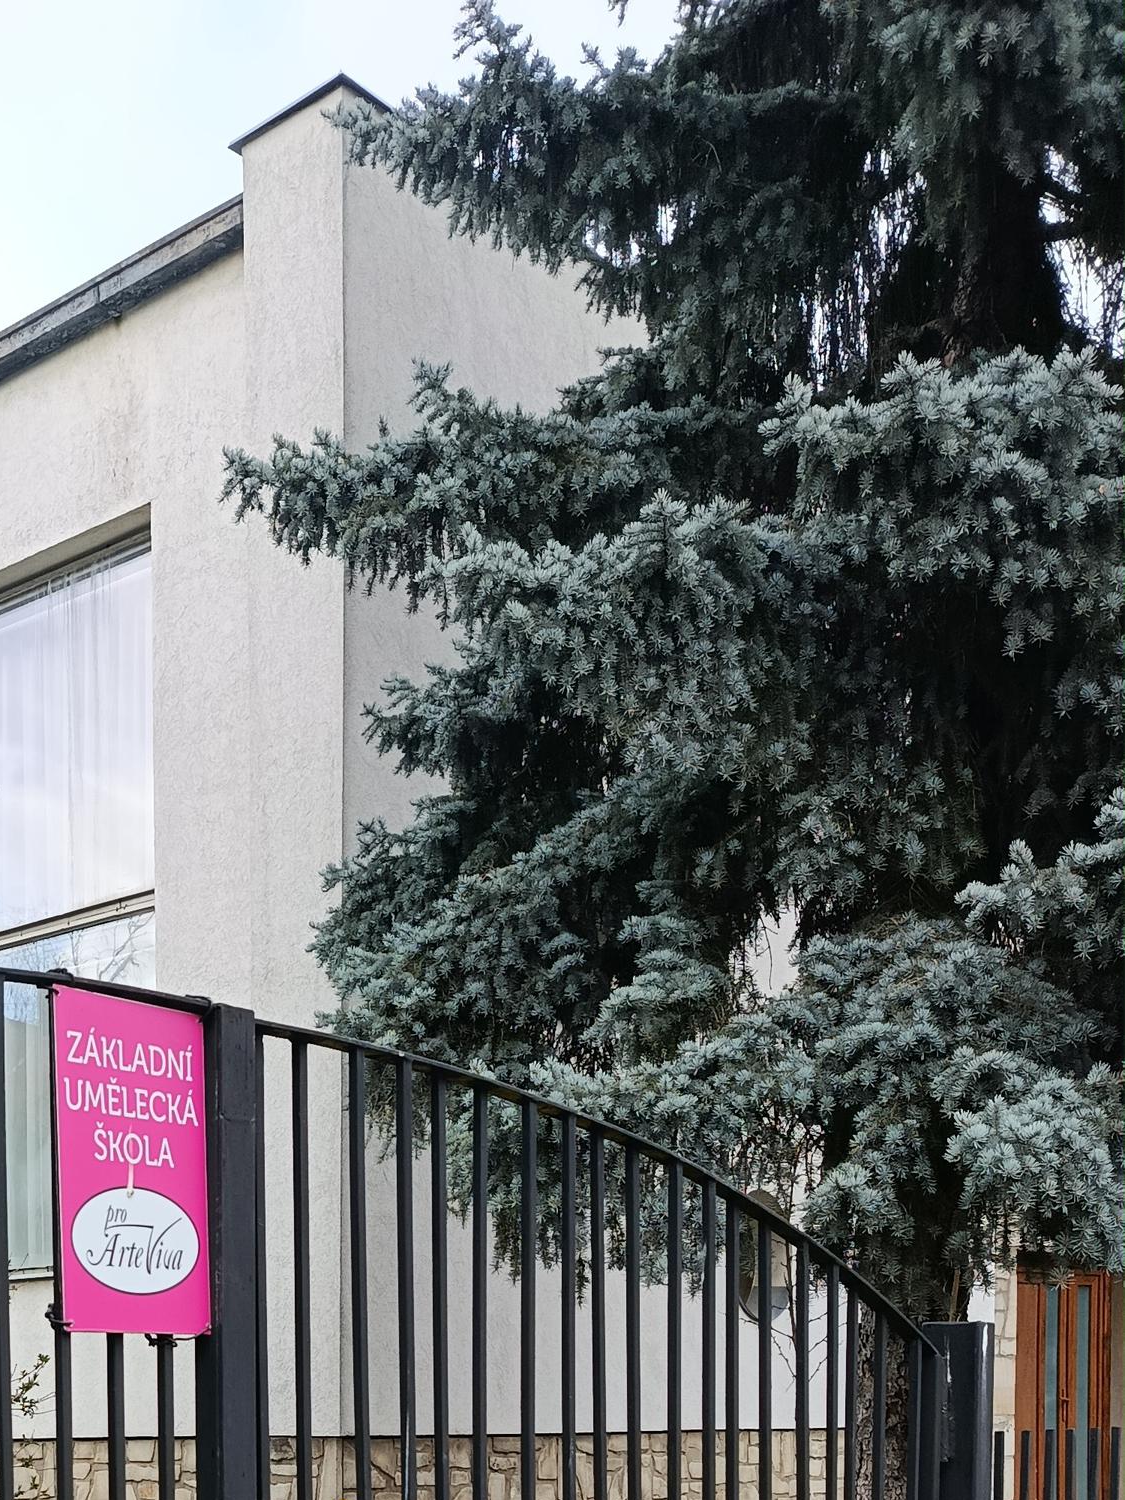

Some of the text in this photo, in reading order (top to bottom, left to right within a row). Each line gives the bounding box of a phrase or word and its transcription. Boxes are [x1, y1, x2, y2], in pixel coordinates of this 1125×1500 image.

[66, 1027, 193, 1082] ZÁKLADNÍ
[63, 1076, 199, 1127] UMĚLECKÁ
[93, 1121, 175, 1168] ŠKOLA
[105, 1204, 128, 1231] pro
